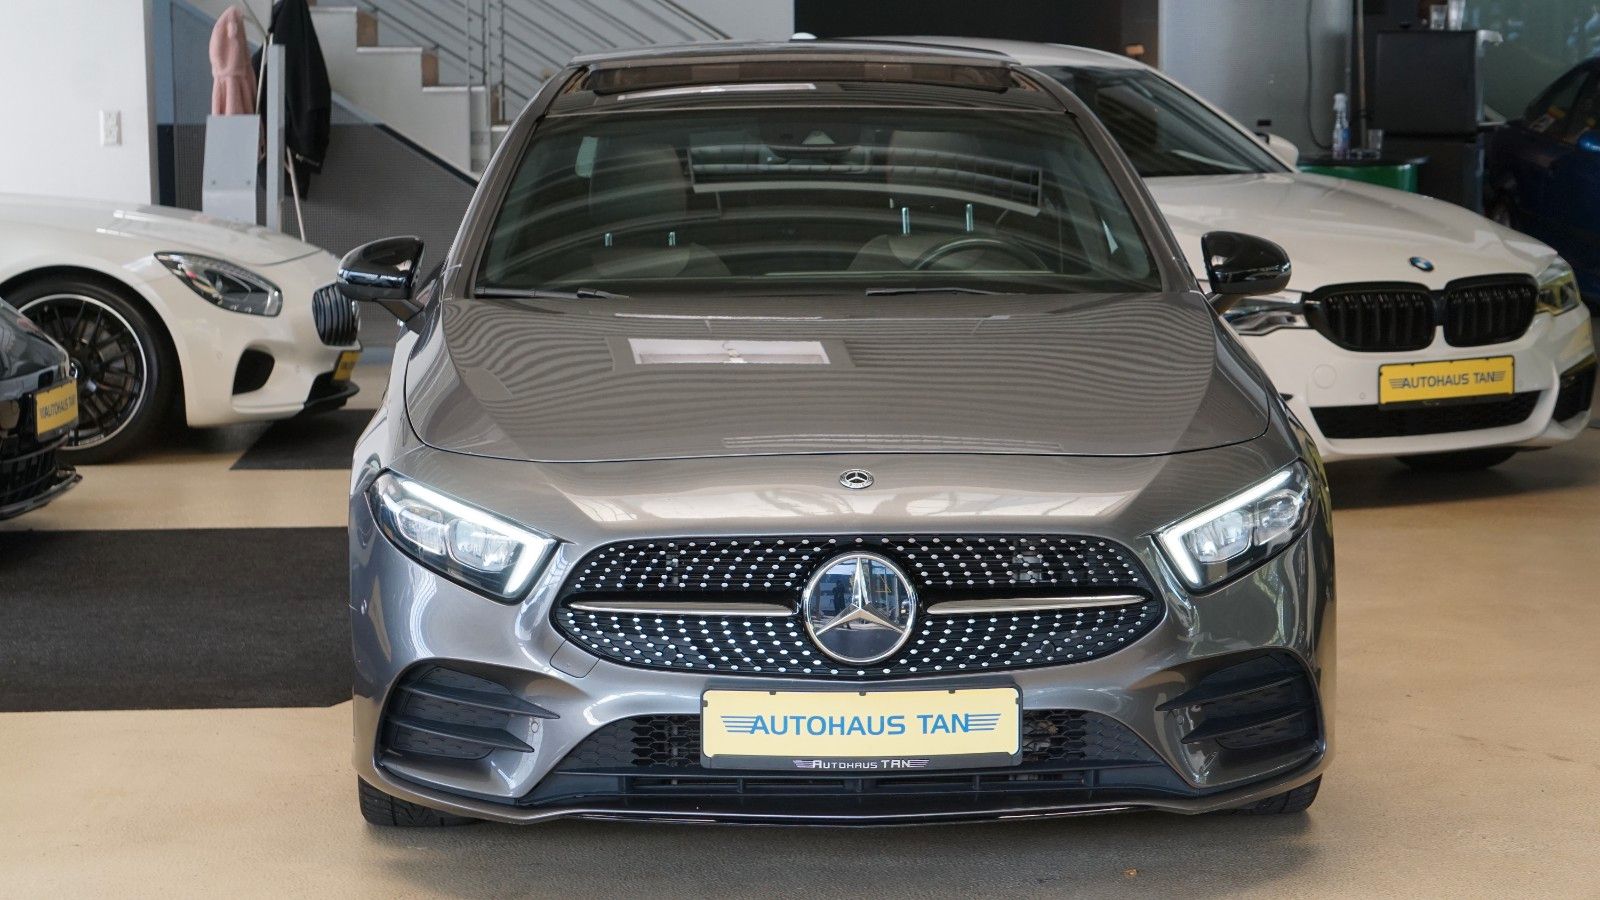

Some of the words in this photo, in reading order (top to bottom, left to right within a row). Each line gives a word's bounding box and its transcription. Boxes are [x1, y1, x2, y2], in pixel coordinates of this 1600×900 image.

[1402, 374, 1469, 389] AUTOHAUS
[1473, 372, 1495, 383] TAN
[750, 715, 905, 736] AUTOHAUS
[916, 713, 969, 734] TAN
[881, 760, 911, 768] TAN
